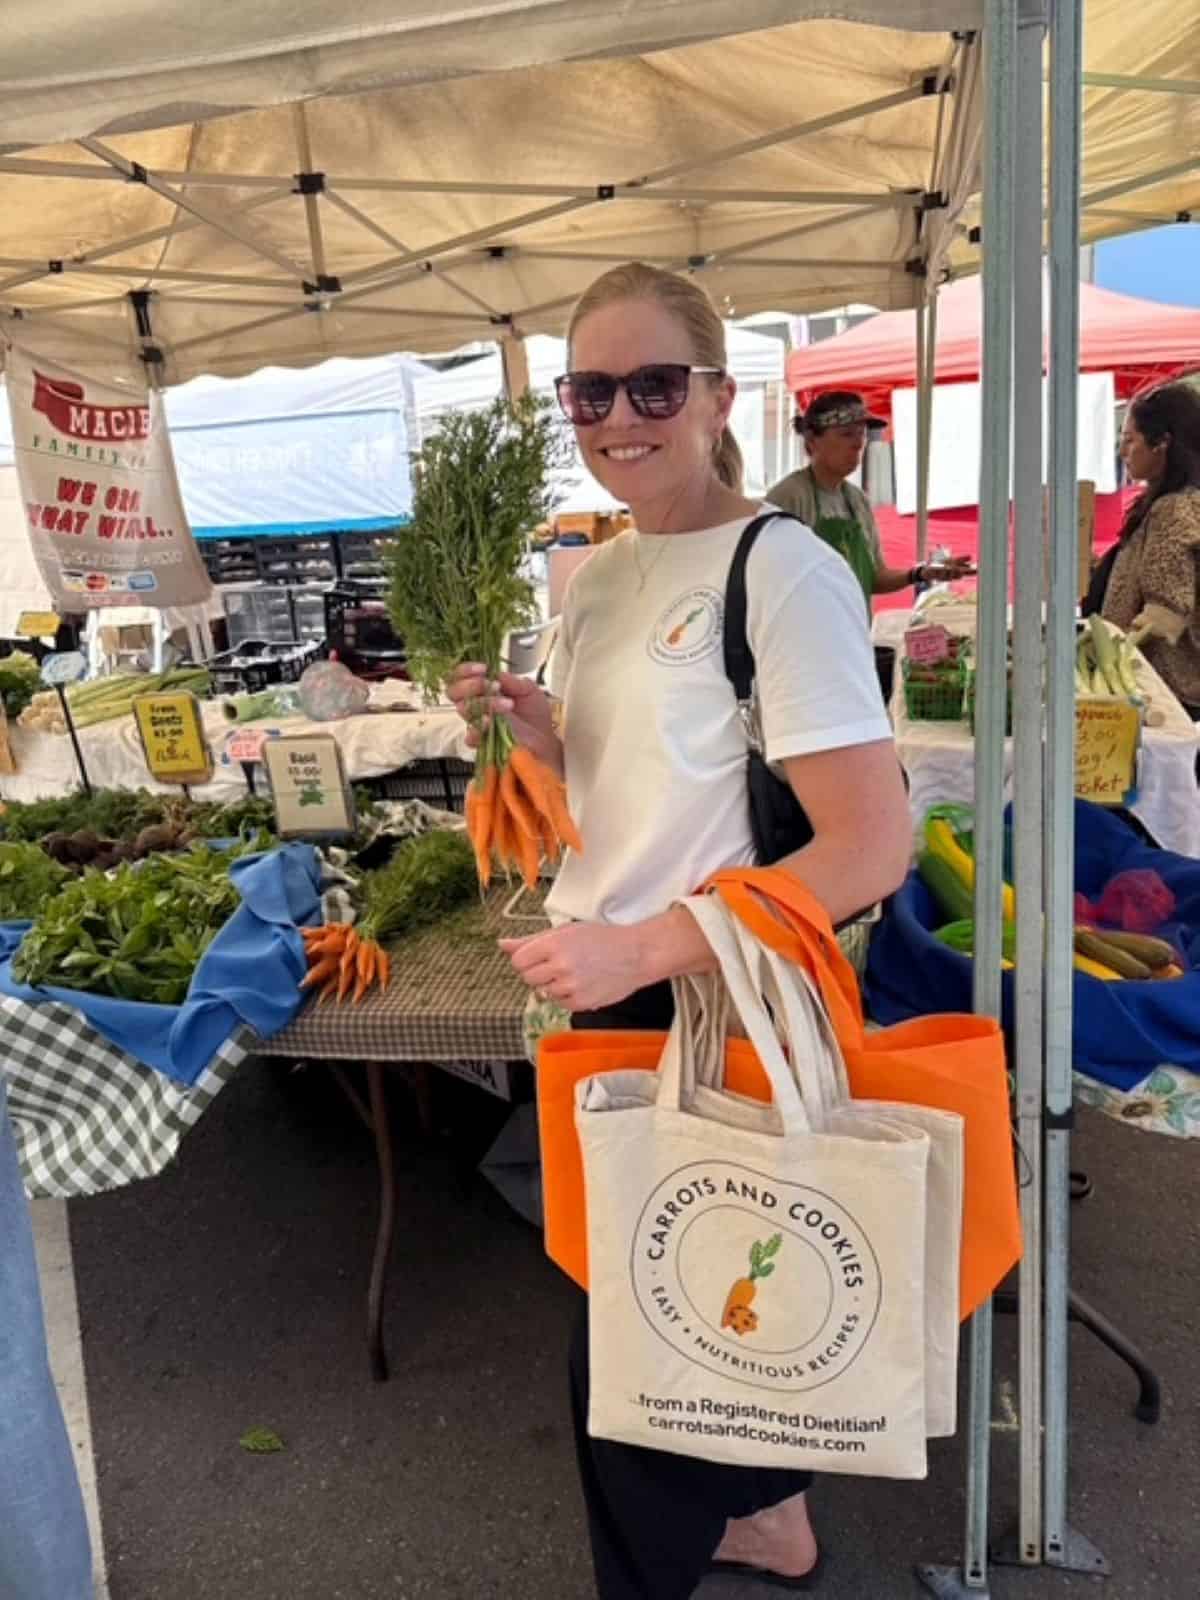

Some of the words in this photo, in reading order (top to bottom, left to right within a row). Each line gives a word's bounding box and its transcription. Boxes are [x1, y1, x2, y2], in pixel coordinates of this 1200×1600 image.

[57, 476, 97, 507] WE
[647, 1177, 717, 1260] CARROTS
[725, 1178, 777, 1208] AND
[788, 1203, 863, 1288] COOKIES
[651, 1286, 682, 1323] EASY
[694, 1335, 805, 1379] NUTRITIOUS
[808, 1313, 860, 1371] RECIPES
[648, 1415, 866, 1453] carrotsandcookies.com
[686, 1400, 697, 1412] a
[700, 1398, 800, 1428] Registered
[803, 1414, 887, 1433] Dietitian!
